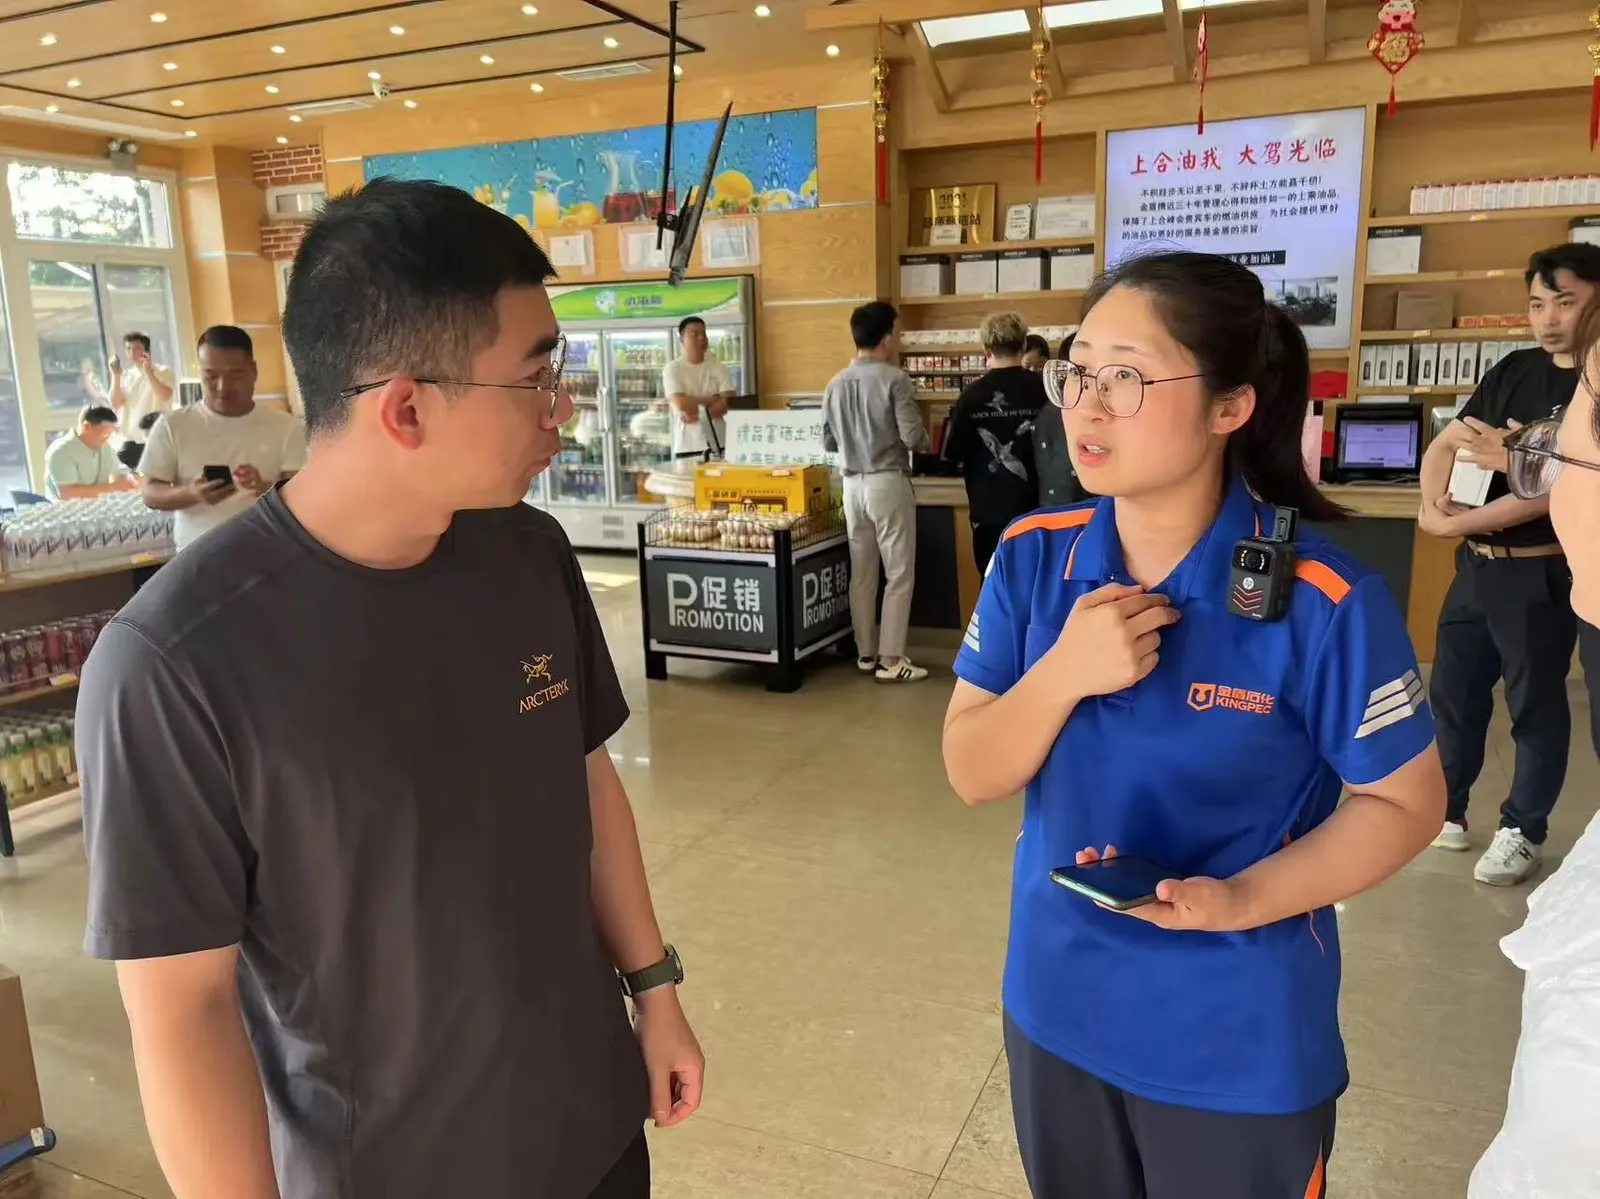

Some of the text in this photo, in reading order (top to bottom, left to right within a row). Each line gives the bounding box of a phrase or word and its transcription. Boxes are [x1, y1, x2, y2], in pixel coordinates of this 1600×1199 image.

[1130, 138, 1337, 175] 上合油我 大驾光临
[702, 576, 760, 612] 促销
[1216, 696, 1272, 714] KINGPEC
